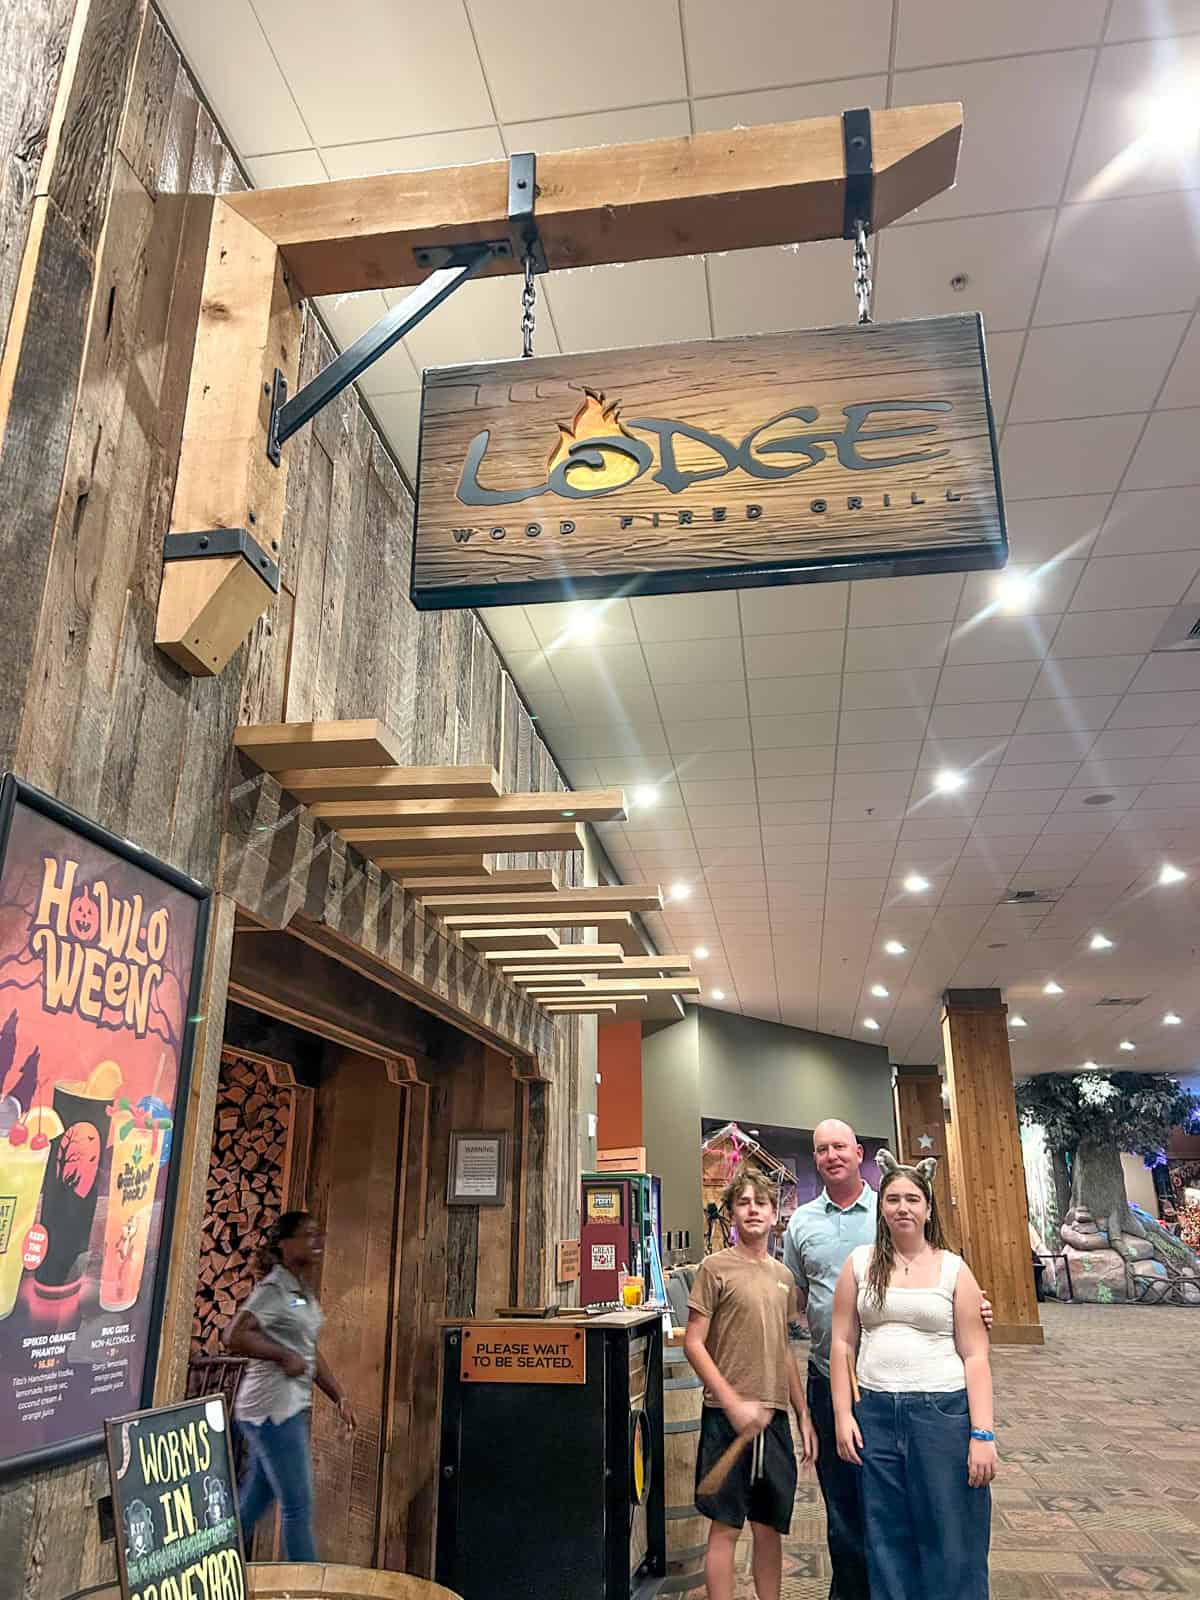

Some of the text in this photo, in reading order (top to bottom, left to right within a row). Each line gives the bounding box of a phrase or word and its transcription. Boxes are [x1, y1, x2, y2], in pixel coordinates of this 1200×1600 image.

[454, 399, 954, 506] LODGE
[451, 488, 962, 544] WOOD FIRED GRILL
[22, 1331, 77, 1348] SPIKED ORANGE
[90, 1333, 137, 1349] NON-ALCOHOLIC
[30, 1344, 66, 1359] PHANTOM
[475, 1343, 569, 1356] PLEASE WAIT
[471, 1355, 575, 1369] TO BE SEATED.
[138, 1419, 211, 1486] WORMS
[159, 1482, 197, 1546] IN
